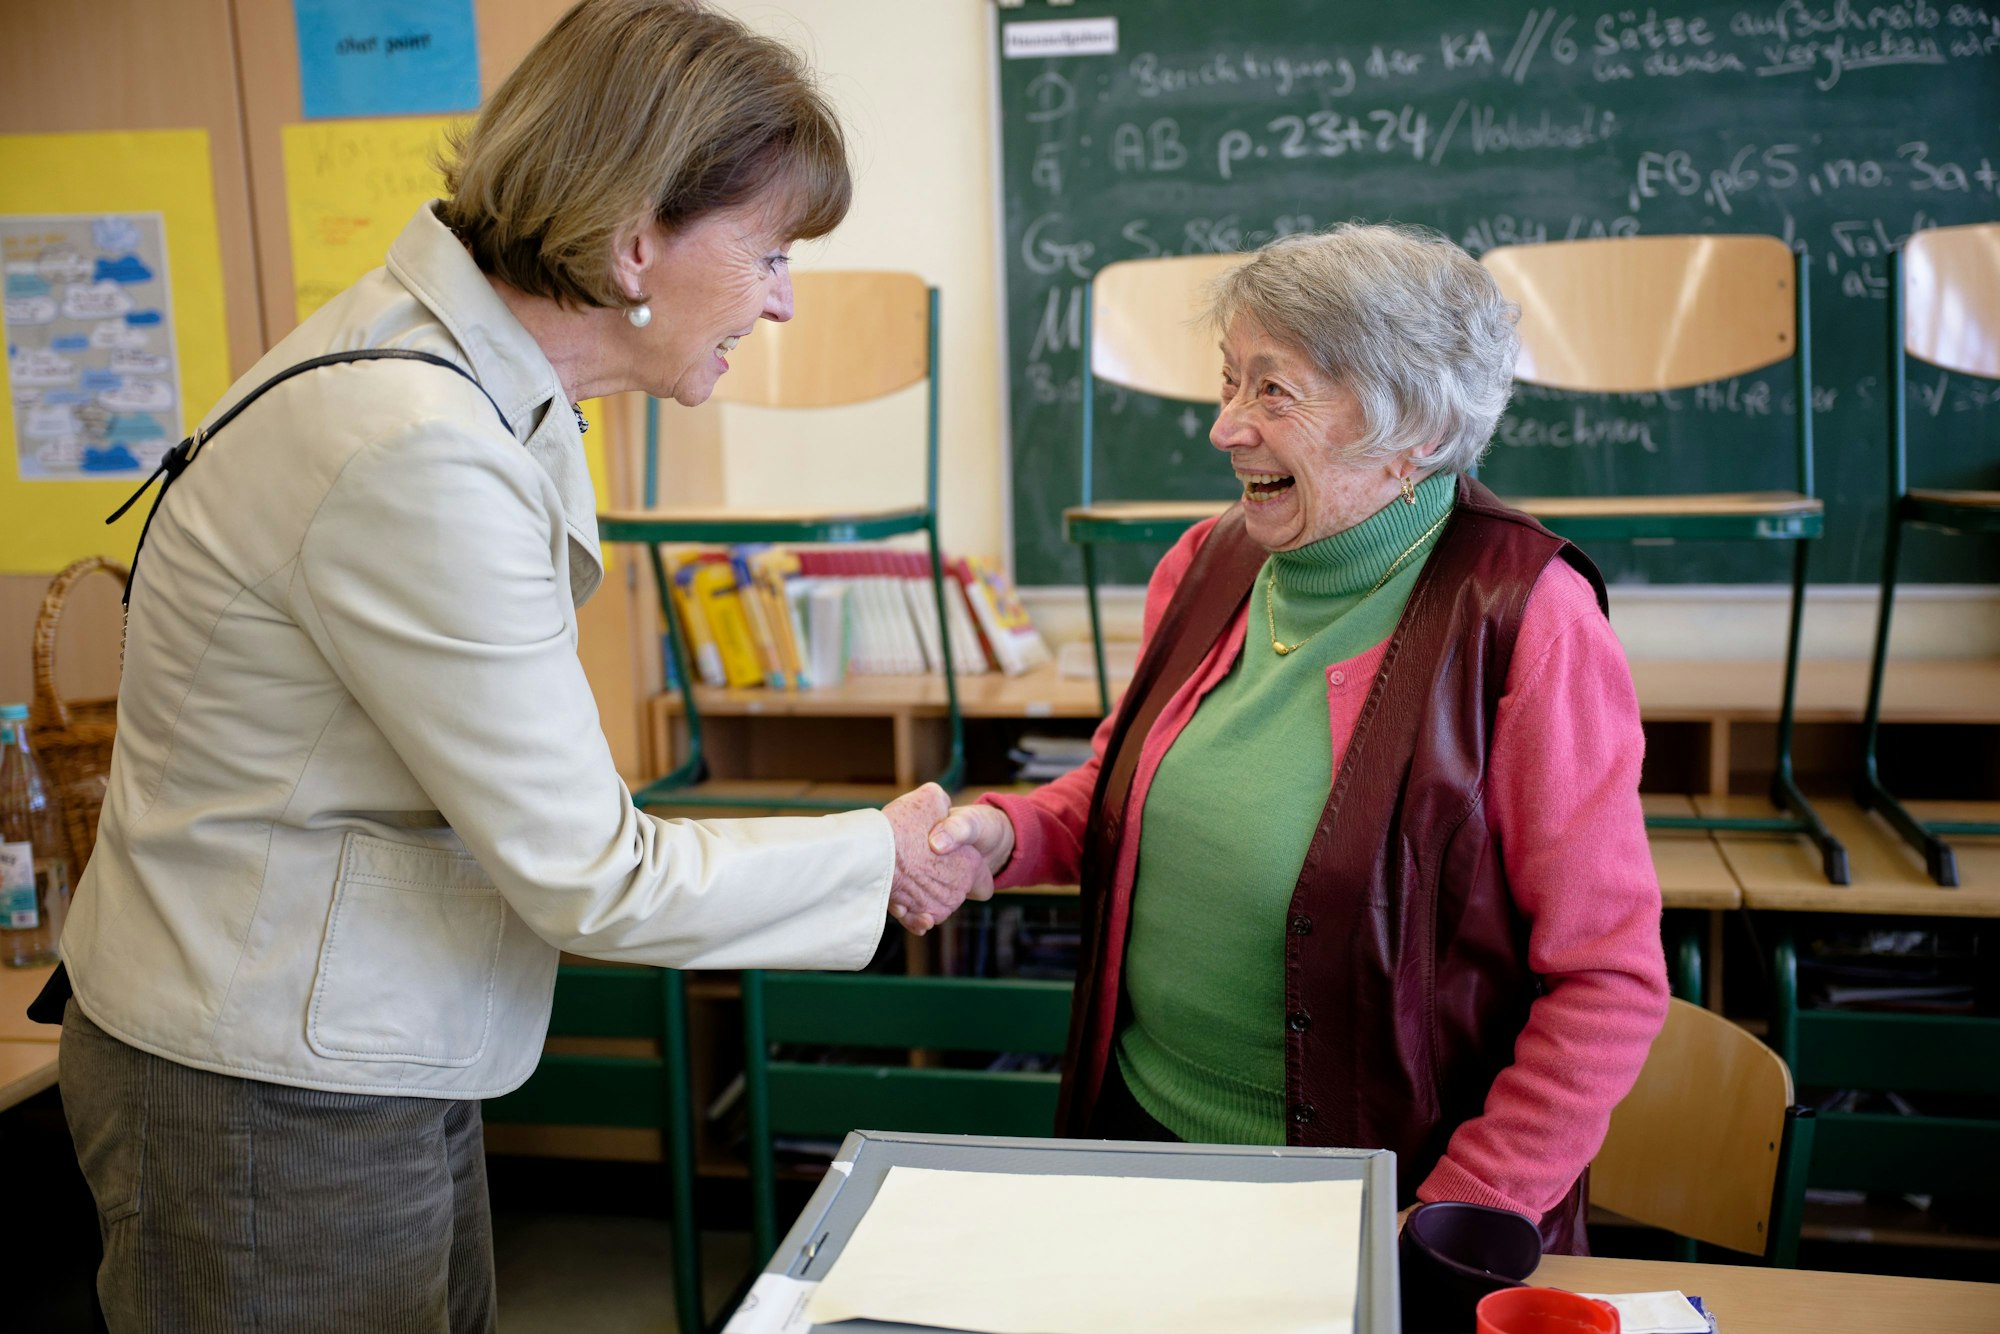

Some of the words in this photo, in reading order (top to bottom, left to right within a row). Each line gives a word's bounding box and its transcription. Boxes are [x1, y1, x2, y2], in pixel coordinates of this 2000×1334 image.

[1129, 51, 1356, 98] Berichtigung
[1365, 43, 1427, 80] der
[1440, 29, 1496, 71] KA
[1113, 117, 1189, 172] AB
